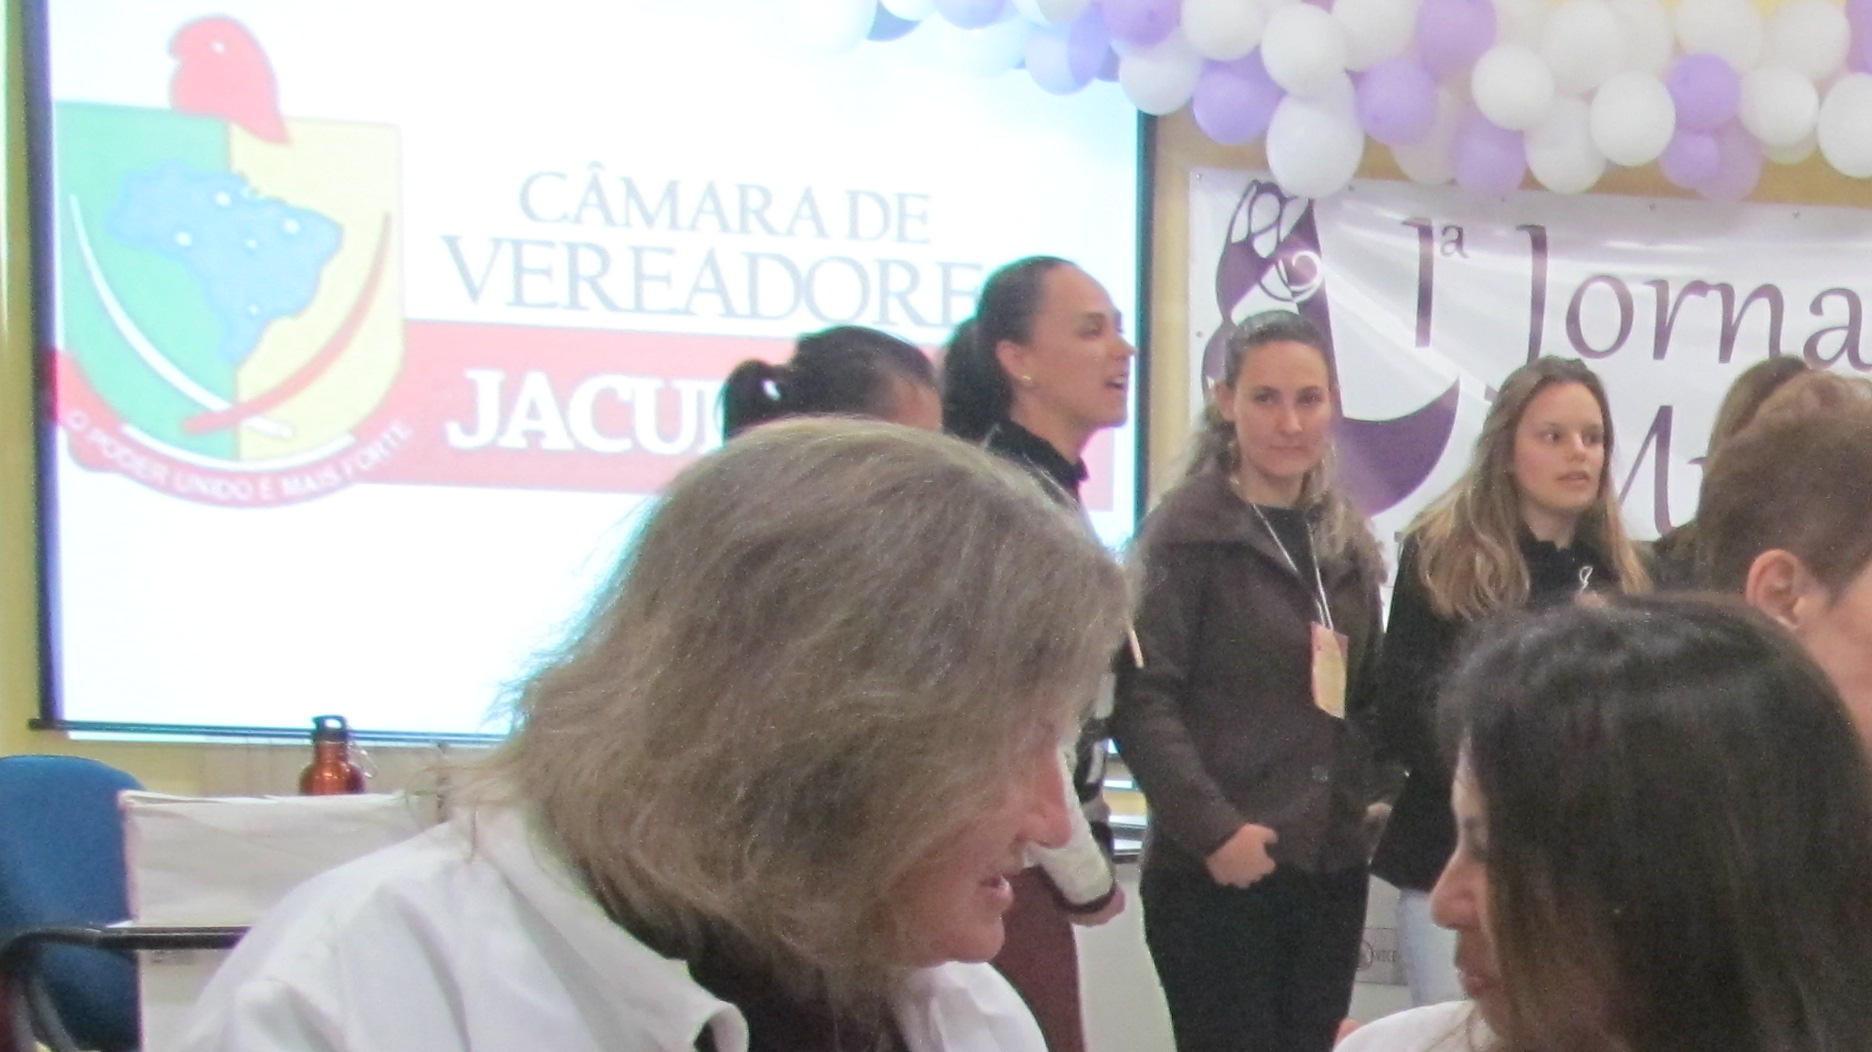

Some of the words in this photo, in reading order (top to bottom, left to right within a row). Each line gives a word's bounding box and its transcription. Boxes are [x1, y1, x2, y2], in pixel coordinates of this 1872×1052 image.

[518, 160, 830, 241] CÂMARA
[846, 187, 933, 245] DE
[440, 234, 985, 330] VEREADORE
[443, 367, 725, 456] JACUI
[87, 426, 170, 484] PODER
[172, 471, 254, 500] UNIDO
[280, 466, 341, 495] MAIS
[341, 419, 413, 477] FORTE
